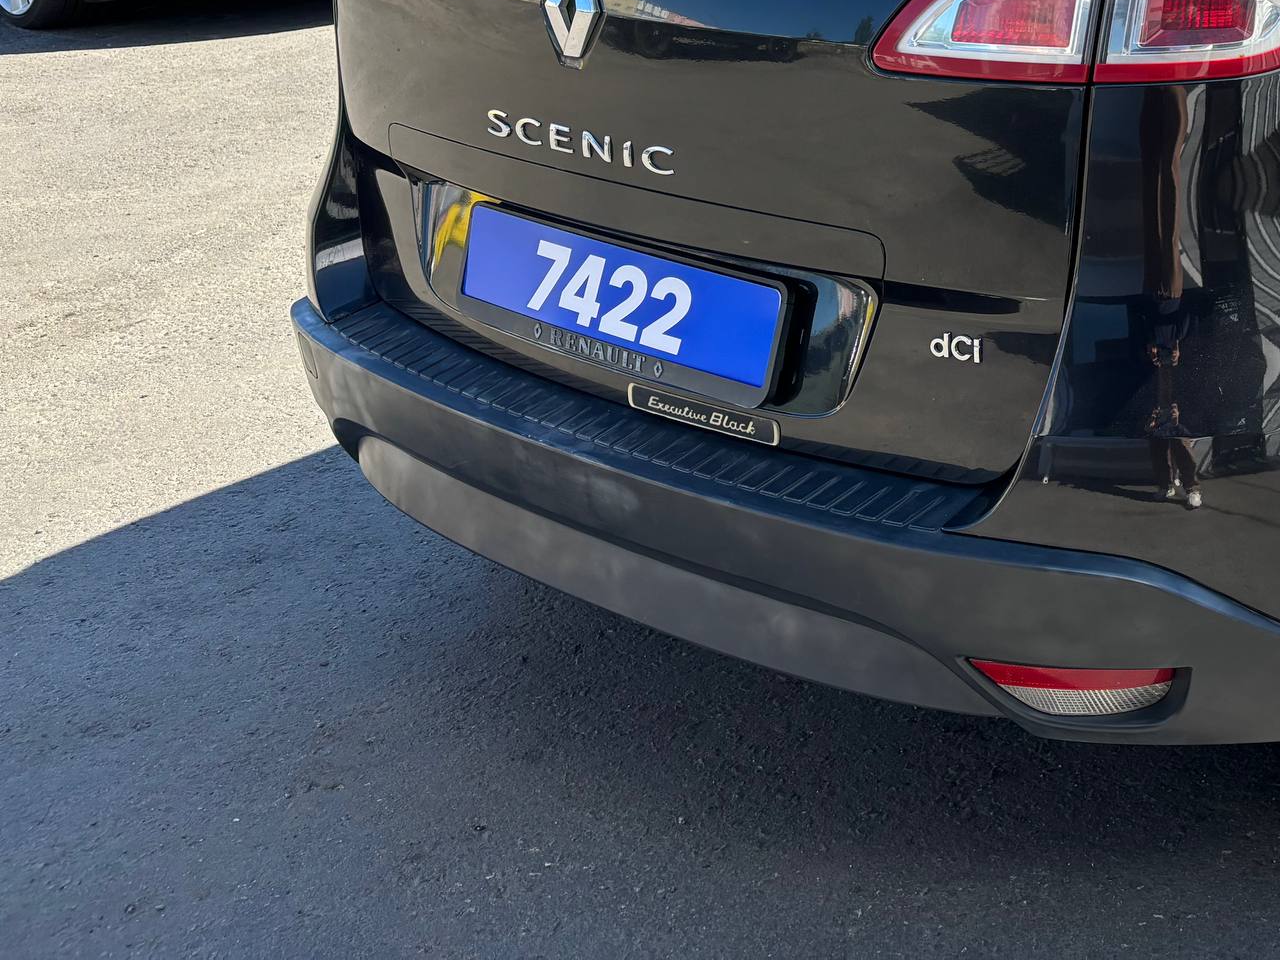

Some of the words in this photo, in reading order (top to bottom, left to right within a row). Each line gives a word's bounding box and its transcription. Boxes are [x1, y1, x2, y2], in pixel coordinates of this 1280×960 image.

[486, 108, 676, 176] SCENIC
[526, 239, 693, 356] 7422
[549, 327, 647, 373] RENAULT
[647, 395, 708, 424] Executive
[708, 411, 756, 436] Black
